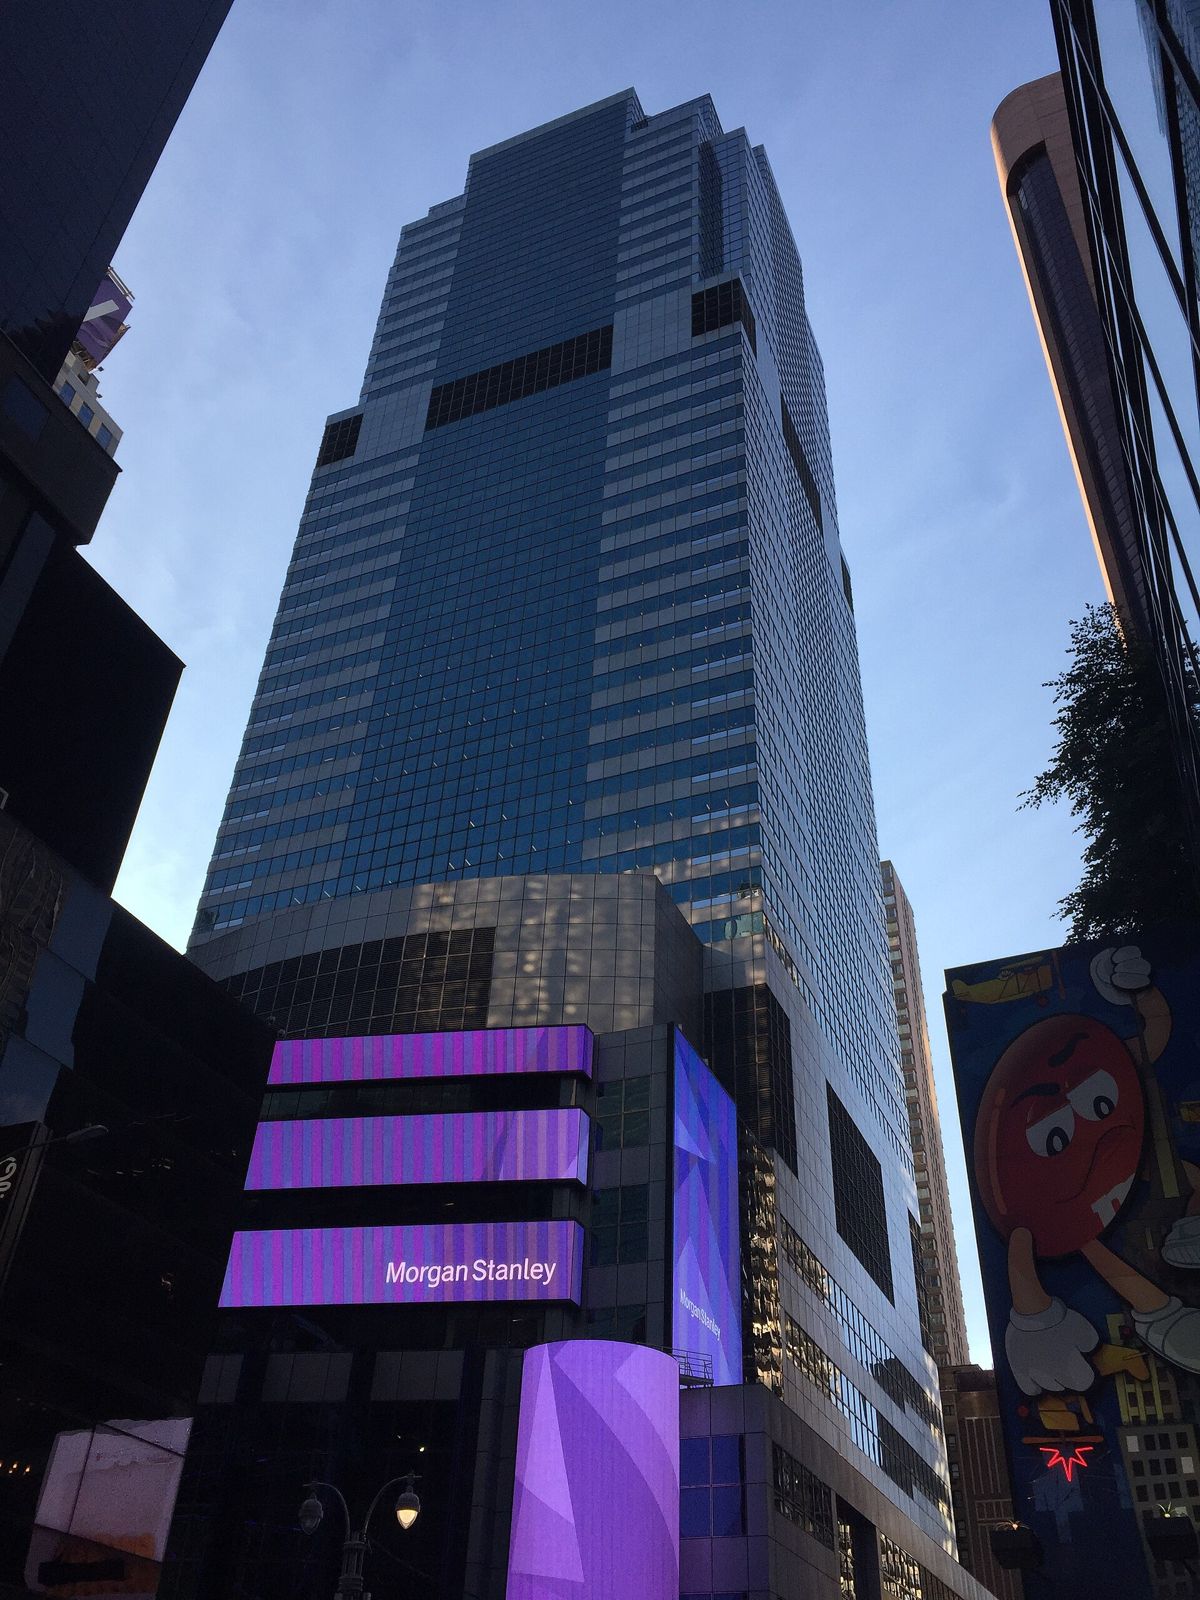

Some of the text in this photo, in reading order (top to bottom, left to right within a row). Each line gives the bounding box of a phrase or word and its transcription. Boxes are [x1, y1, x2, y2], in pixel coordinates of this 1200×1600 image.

[385, 1257, 557, 1288] Morgan Stanley
[680, 1288, 721, 1341] Morgan Stanley
